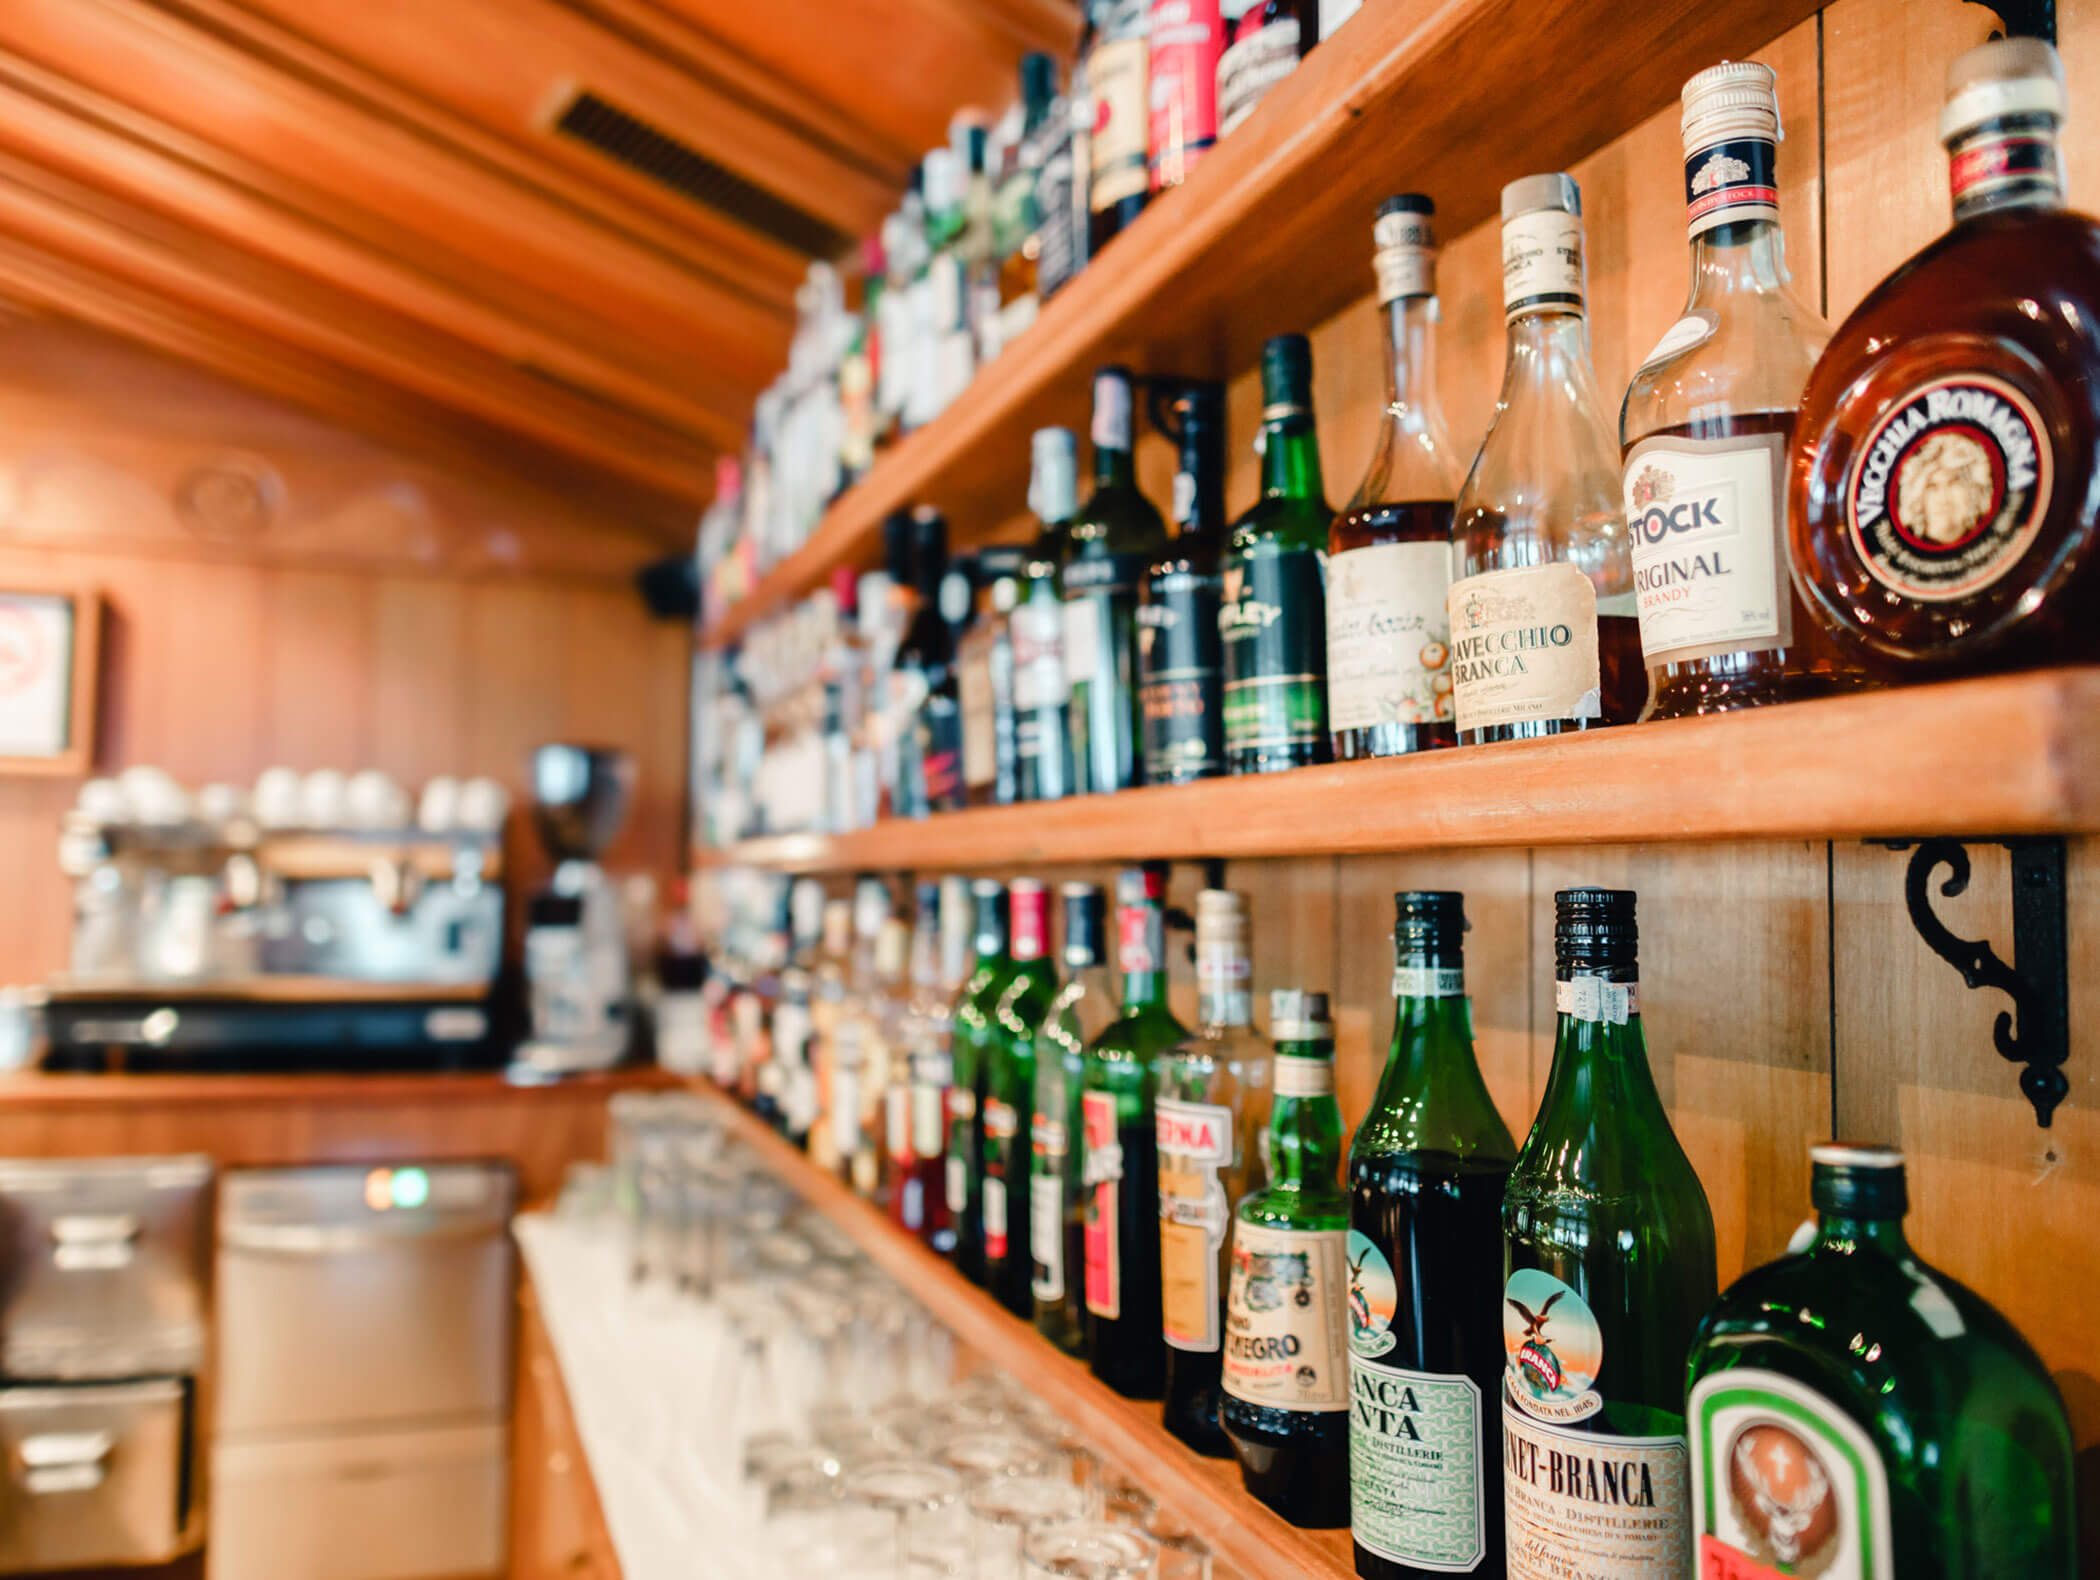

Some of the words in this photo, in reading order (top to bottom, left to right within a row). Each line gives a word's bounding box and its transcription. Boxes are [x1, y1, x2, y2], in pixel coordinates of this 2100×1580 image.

[1856, 406, 1930, 529] VECCHIA
[1926, 387, 2037, 490] ROMAGNA
[1635, 552, 1732, 594] RIGINAL
[1520, 1349, 1557, 1388] BRANCA
[1554, 1407, 1570, 1417] NEL
[1573, 1399, 1594, 1415] 1845
[1566, 1508, 1669, 1529] DISTILLERIE
